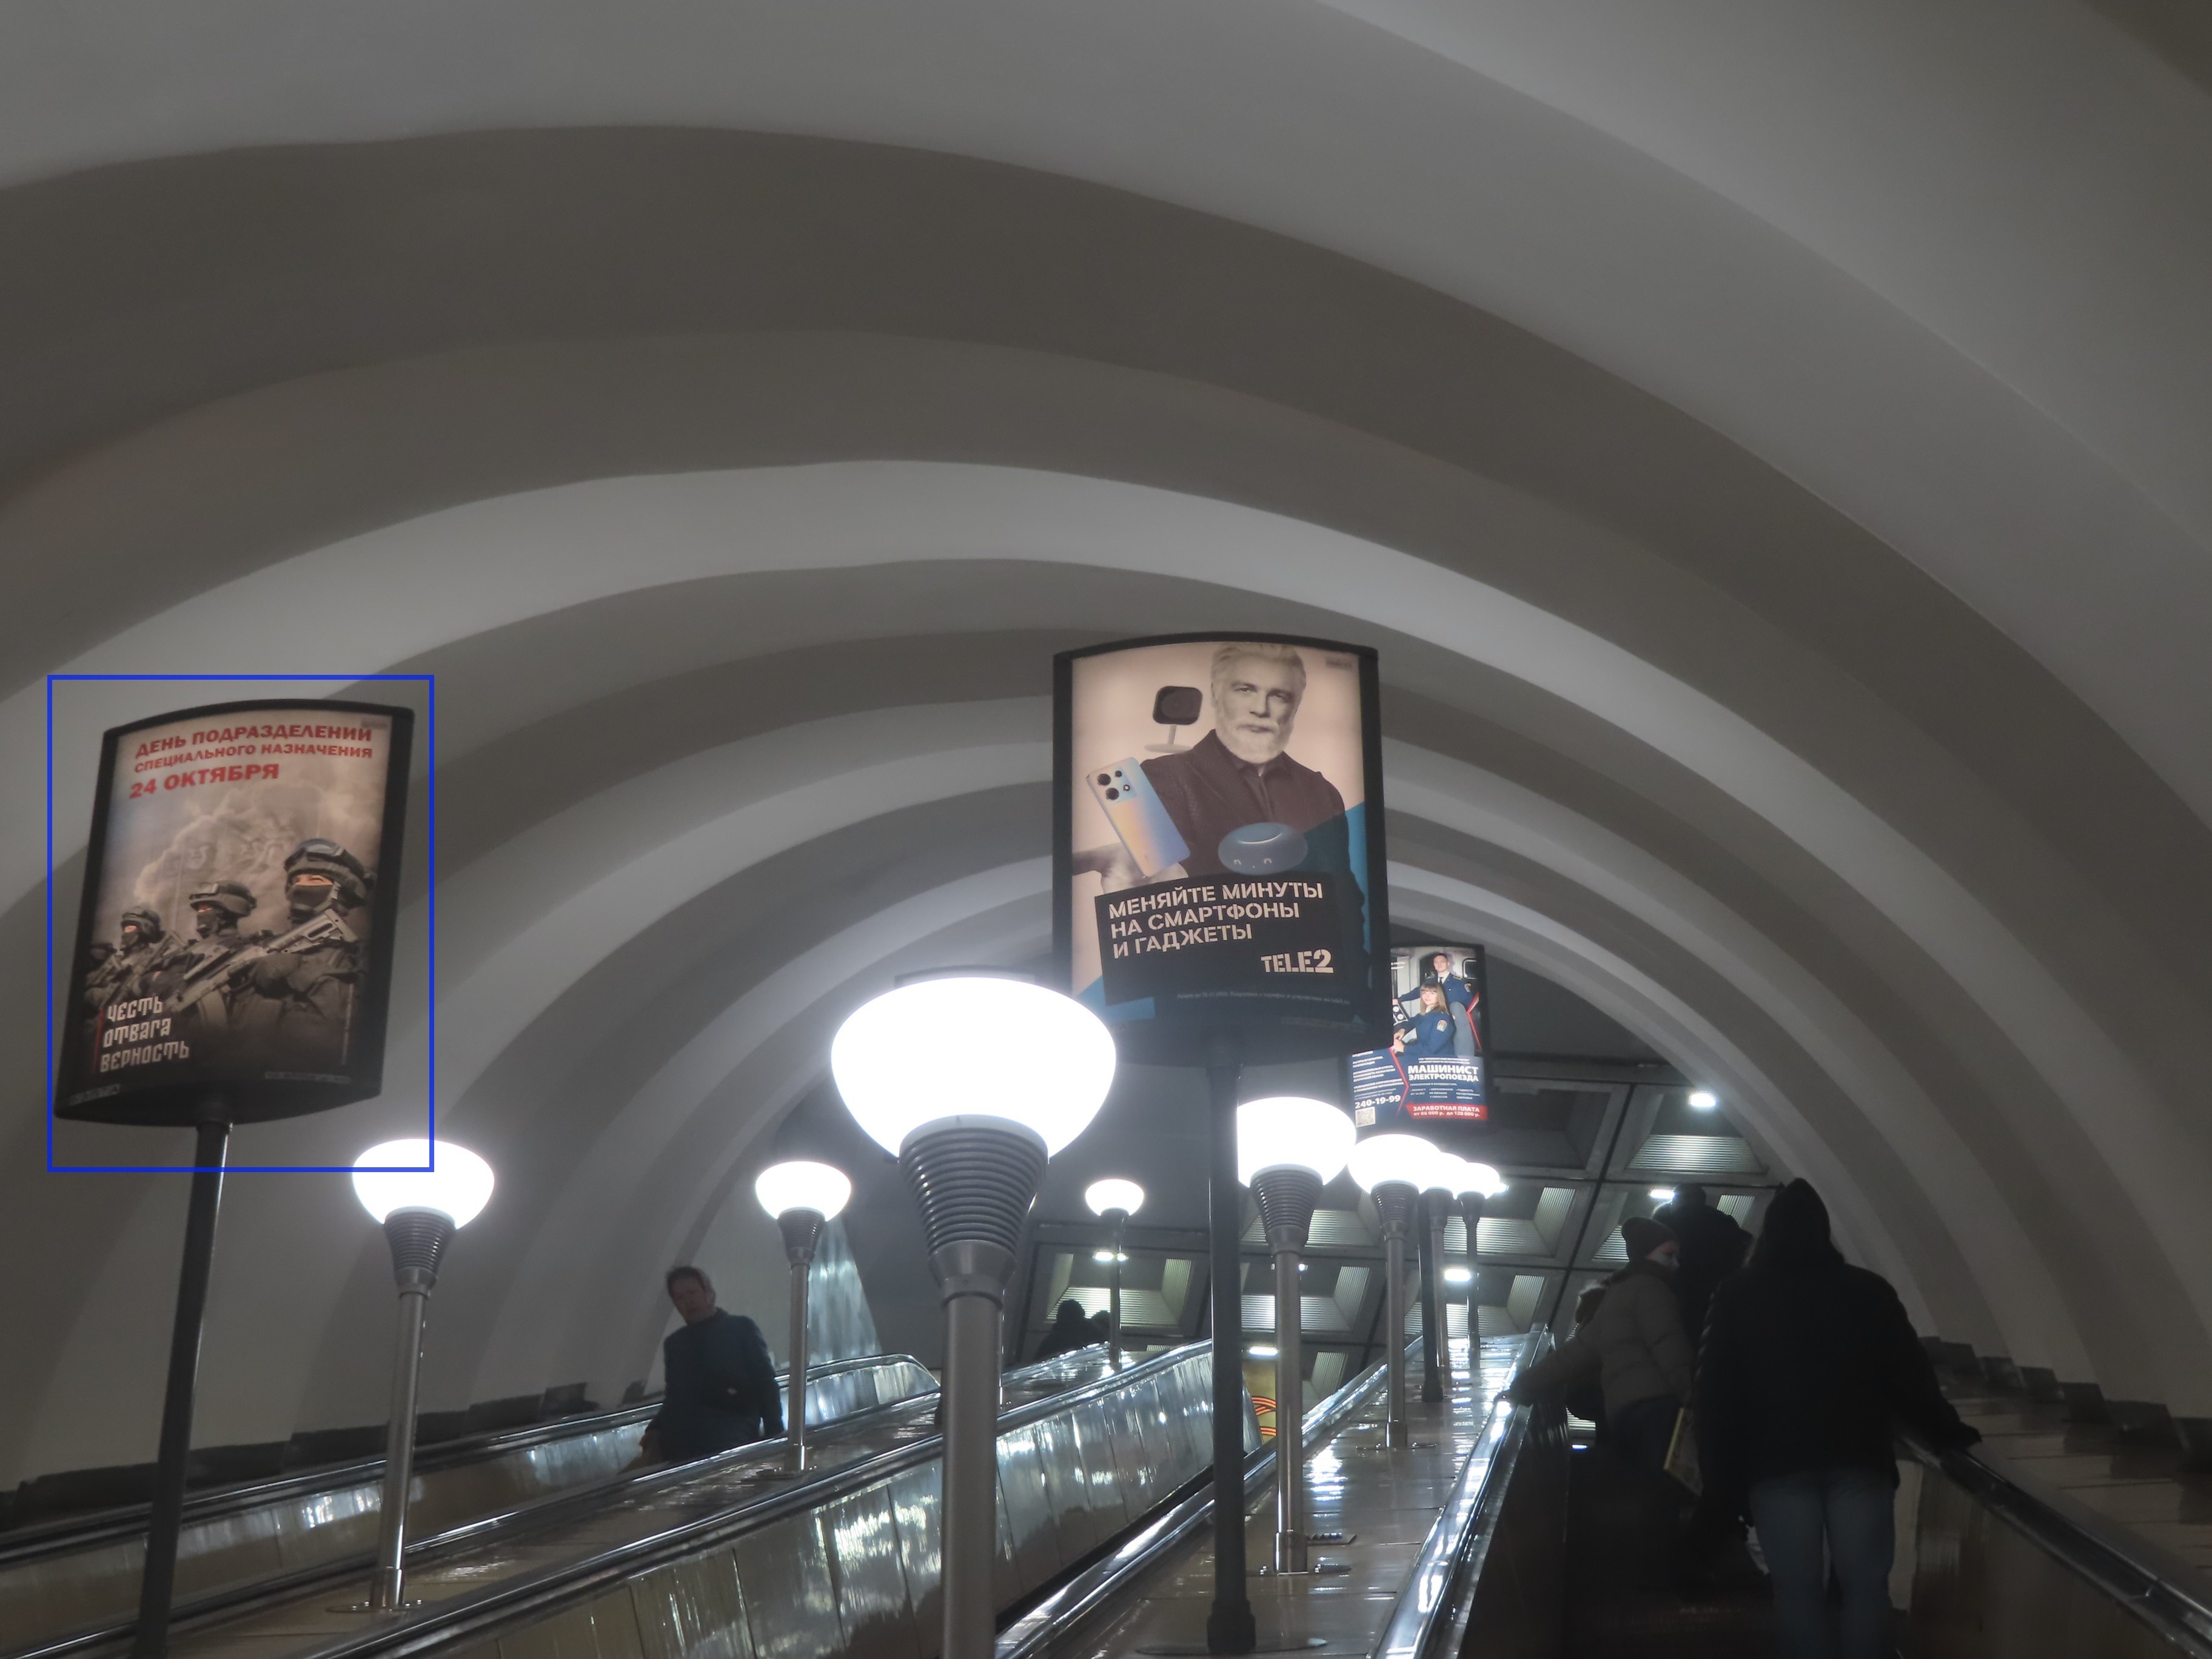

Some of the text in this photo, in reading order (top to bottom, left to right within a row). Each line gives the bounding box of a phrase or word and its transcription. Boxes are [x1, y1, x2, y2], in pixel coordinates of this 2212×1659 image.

[135, 744, 372, 773] СПЕЦИАЛЬНОГО НАЗНАЧЕНИЯ
[136, 736, 186, 759] ДЕНЬ
[129, 763, 279, 799] 24 ОКТЯБРЯ
[1108, 882, 1322, 919] МЕНЯЙТЕ МИНУТЫ
[1111, 902, 1299, 939] НА СМАРТФОНЫ
[1113, 923, 1252, 959] И ГАДЖЕТЫ
[1261, 949, 1333, 973] TELE2
[1407, 1064, 1479, 1075] МАШИНИСТ
[1408, 1074, 1480, 1082] ЭЛЕКТРОПОЕЗДА
[1355, 1094, 1401, 1109] 240-19-99
